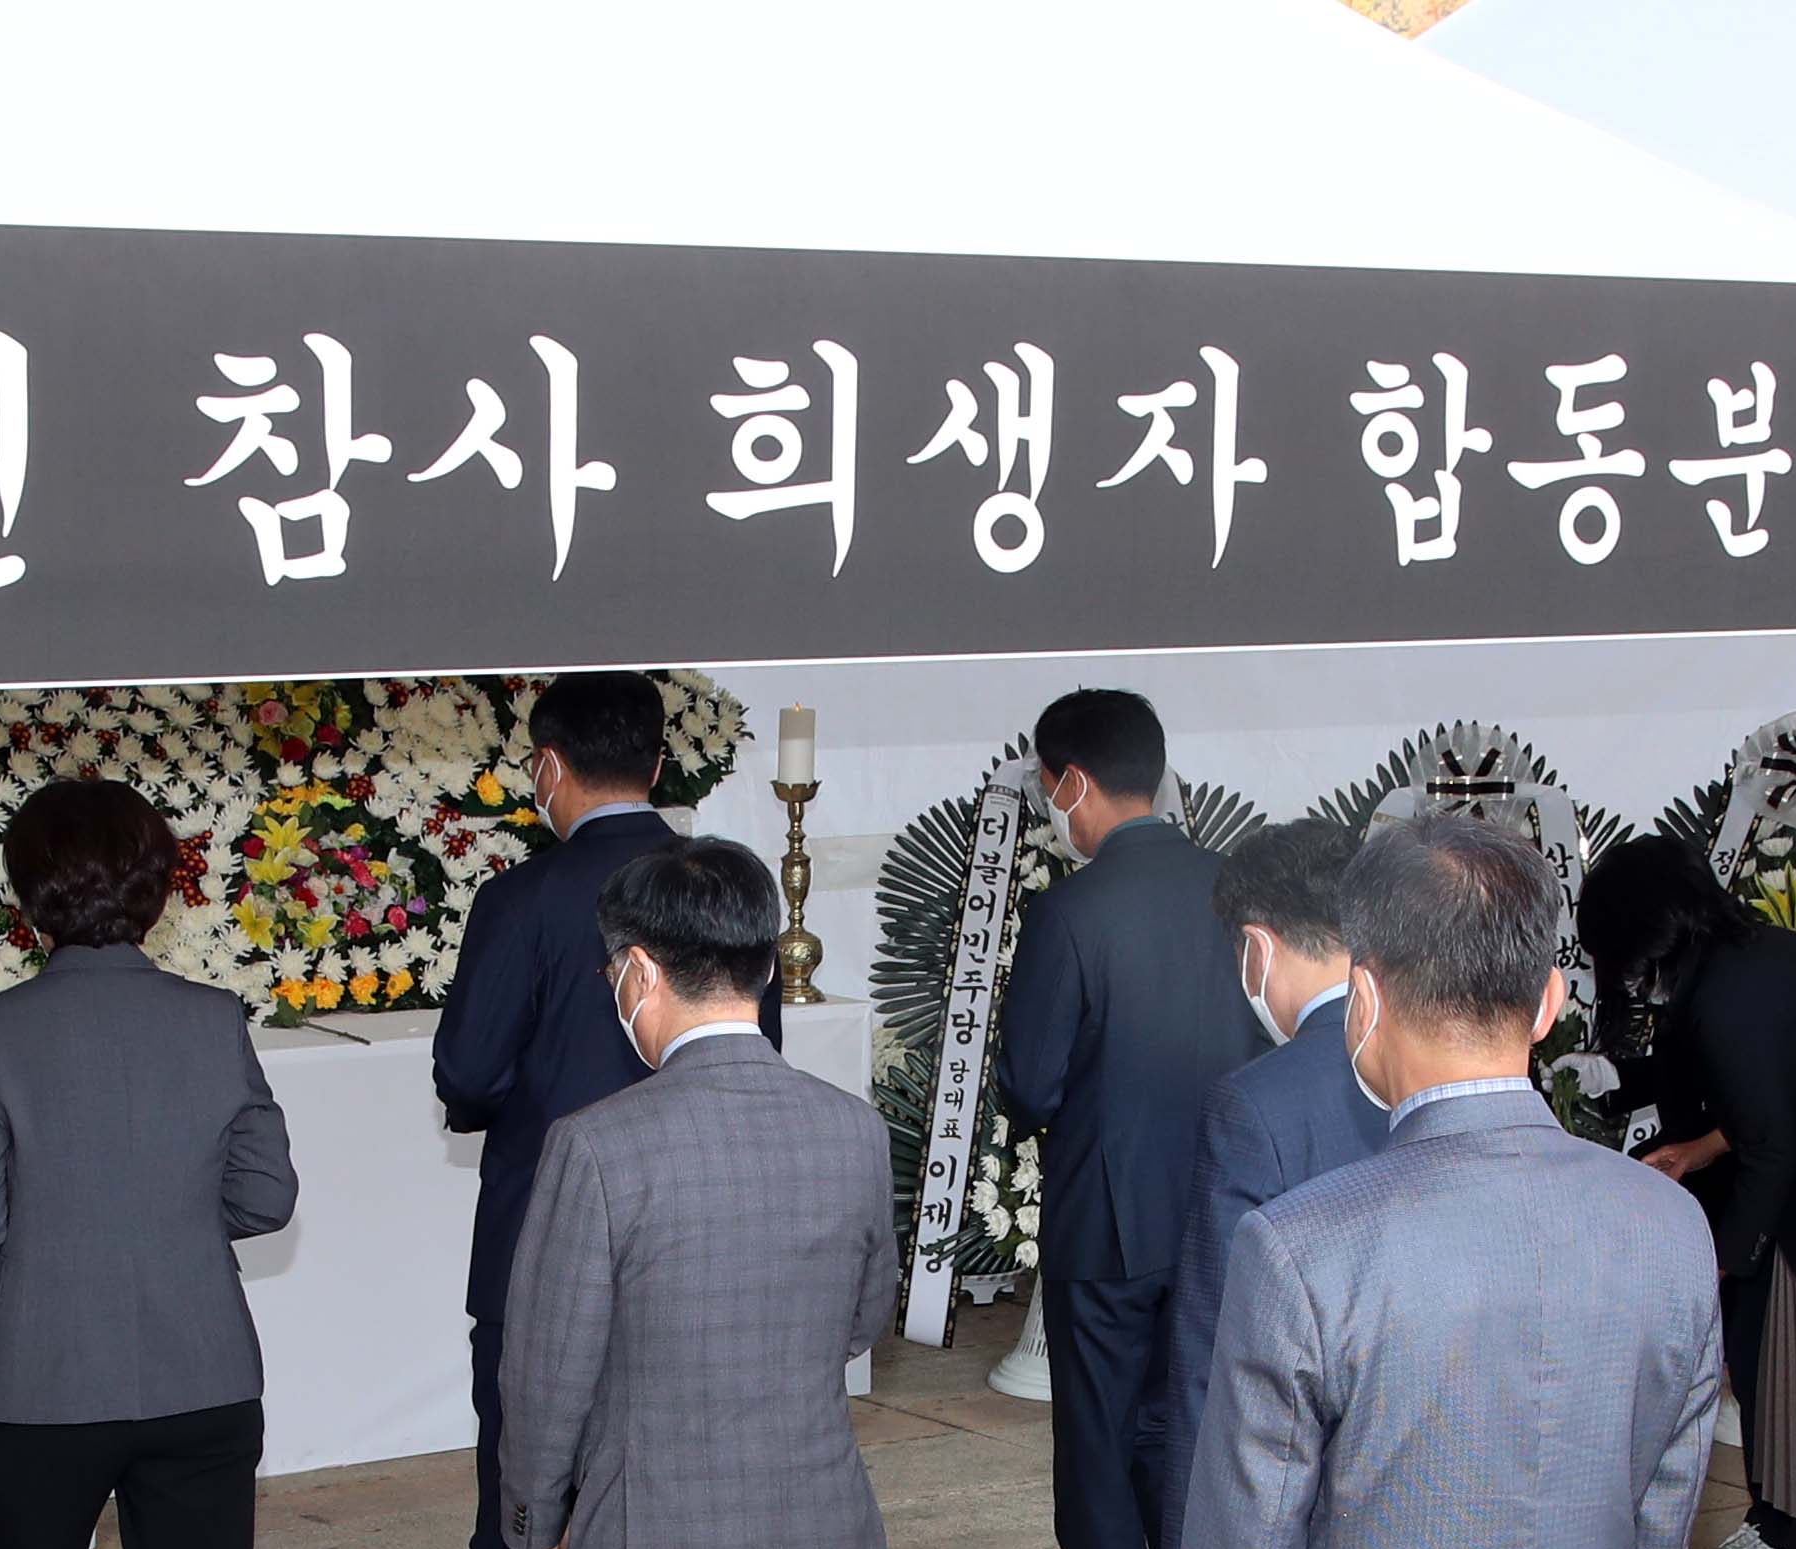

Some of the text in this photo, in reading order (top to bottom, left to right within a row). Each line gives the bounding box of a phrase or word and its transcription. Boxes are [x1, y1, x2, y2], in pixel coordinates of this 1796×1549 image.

[184, 332, 617, 584] 참사
[705, 339, 1267, 580] 희생자
[950, 811, 1009, 1046] 더불어민주당
[938, 1058, 971, 1141] 당대표
